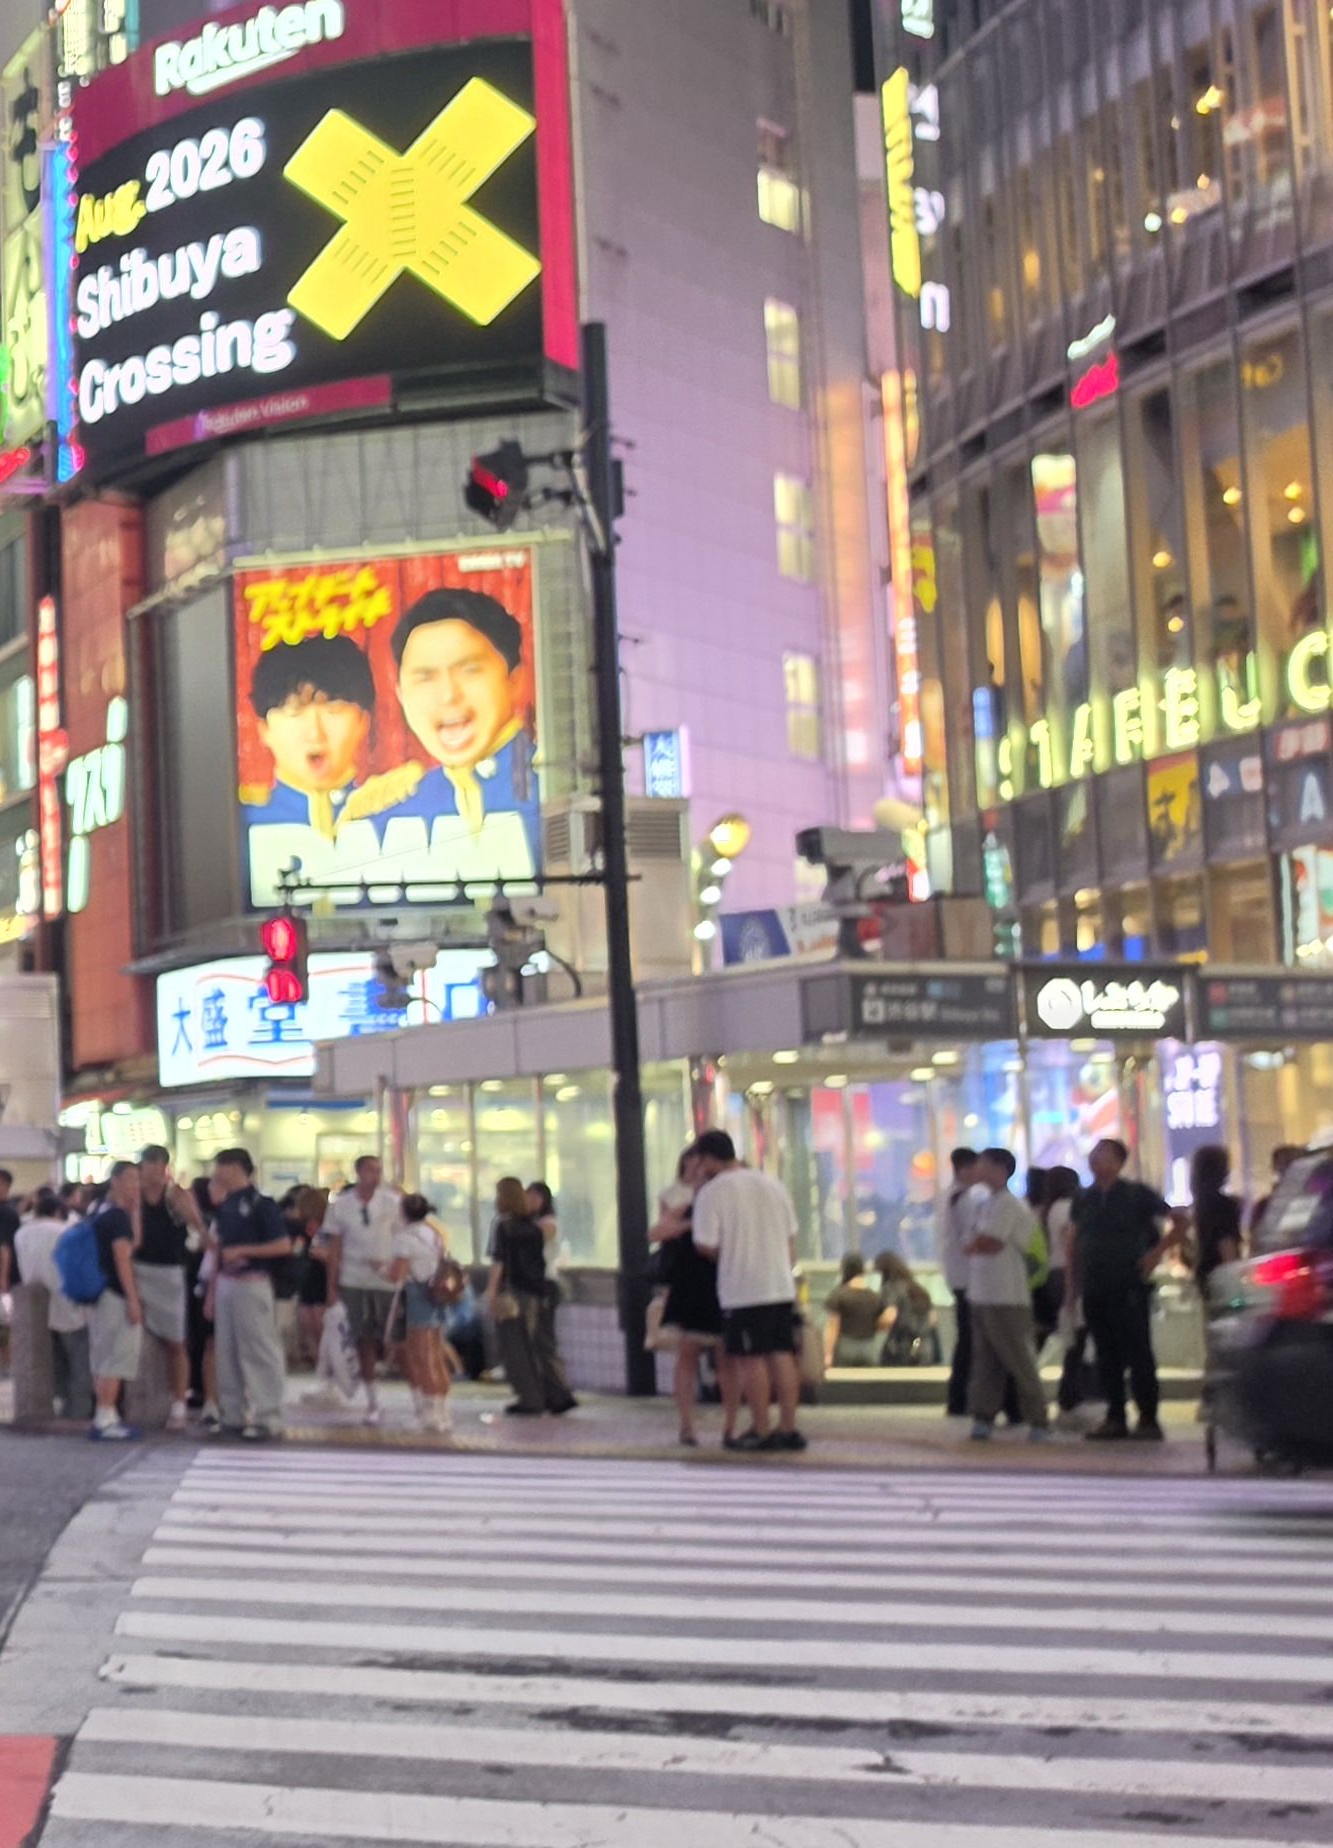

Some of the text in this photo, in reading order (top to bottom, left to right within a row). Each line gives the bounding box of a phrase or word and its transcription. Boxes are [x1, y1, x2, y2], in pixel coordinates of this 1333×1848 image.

[154, 0, 344, 96] Rakuten
[144, 117, 266, 213] 2026
[76, 226, 263, 340] Shibuya
[76, 307, 298, 426] Crossing
